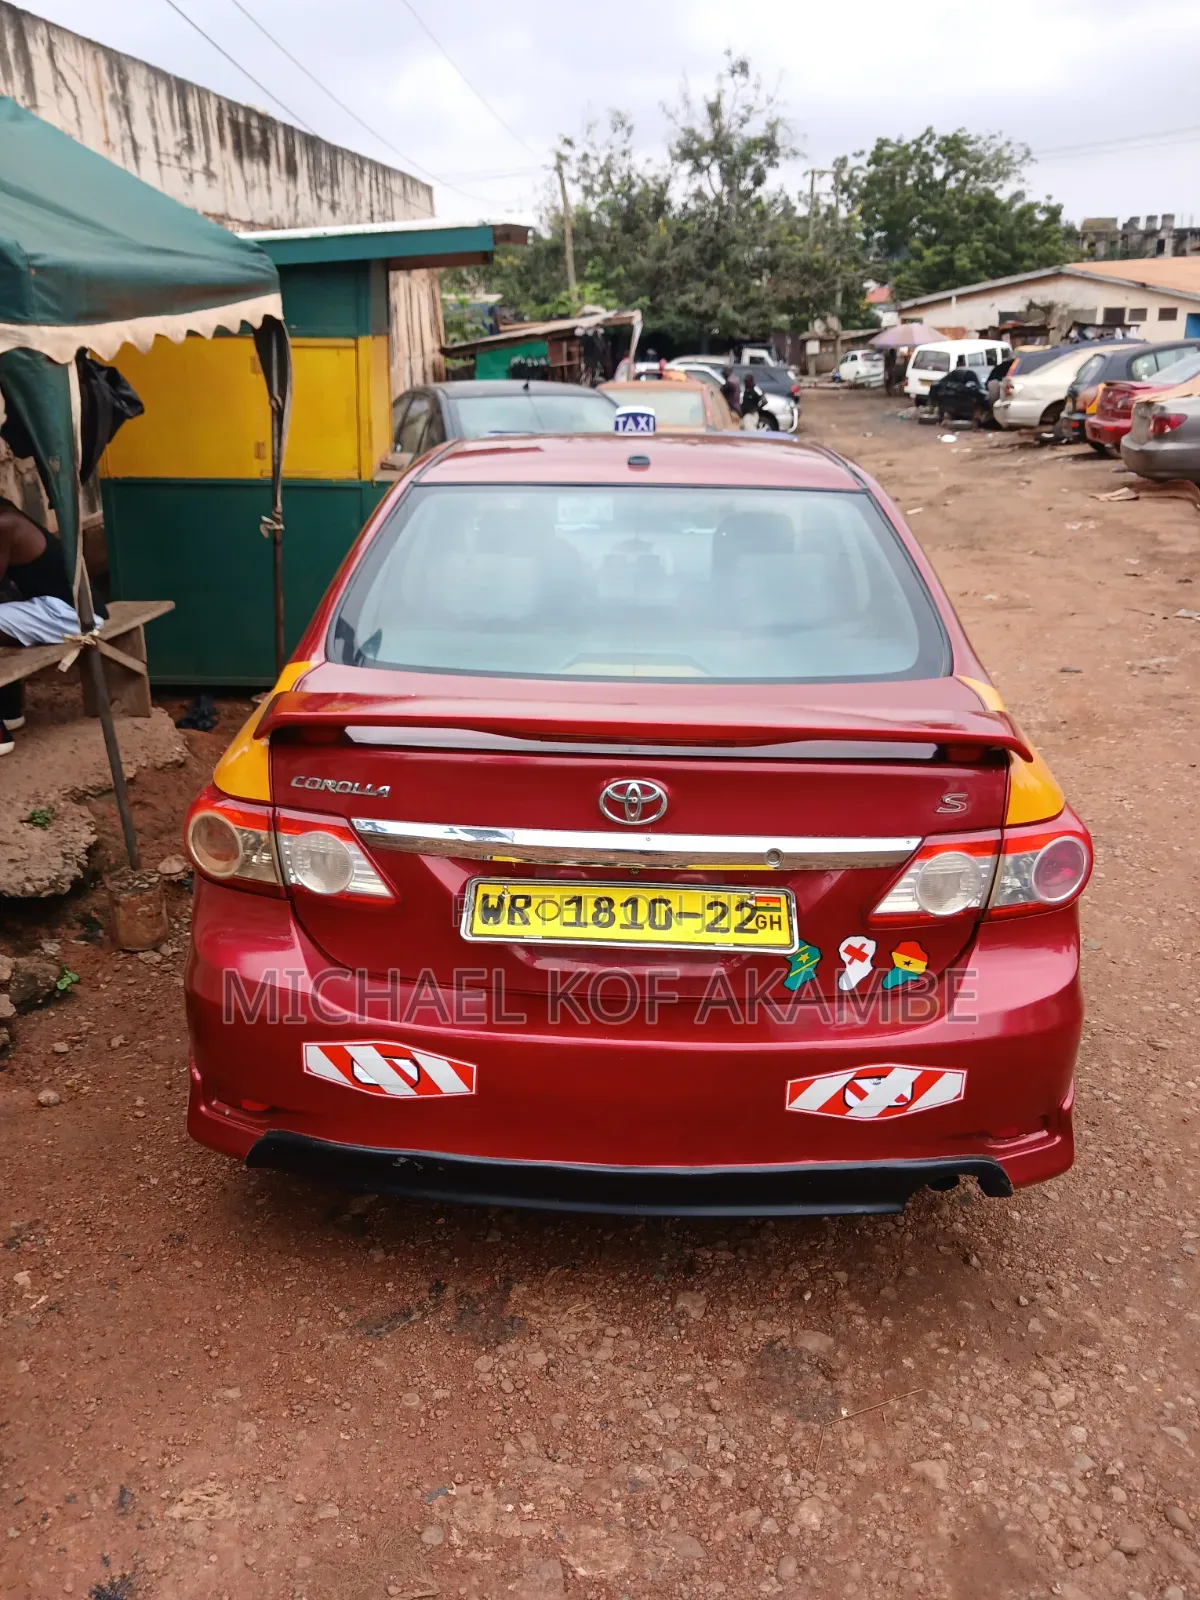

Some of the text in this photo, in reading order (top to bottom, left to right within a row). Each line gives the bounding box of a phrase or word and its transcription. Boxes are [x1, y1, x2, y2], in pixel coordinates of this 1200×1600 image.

[615, 416, 655, 432] TAXI
[290, 775, 391, 798] COROLLA
[935, 792, 969, 814] S
[481, 893, 759, 934] WR 1810-22
[754, 914, 783, 932] GH
